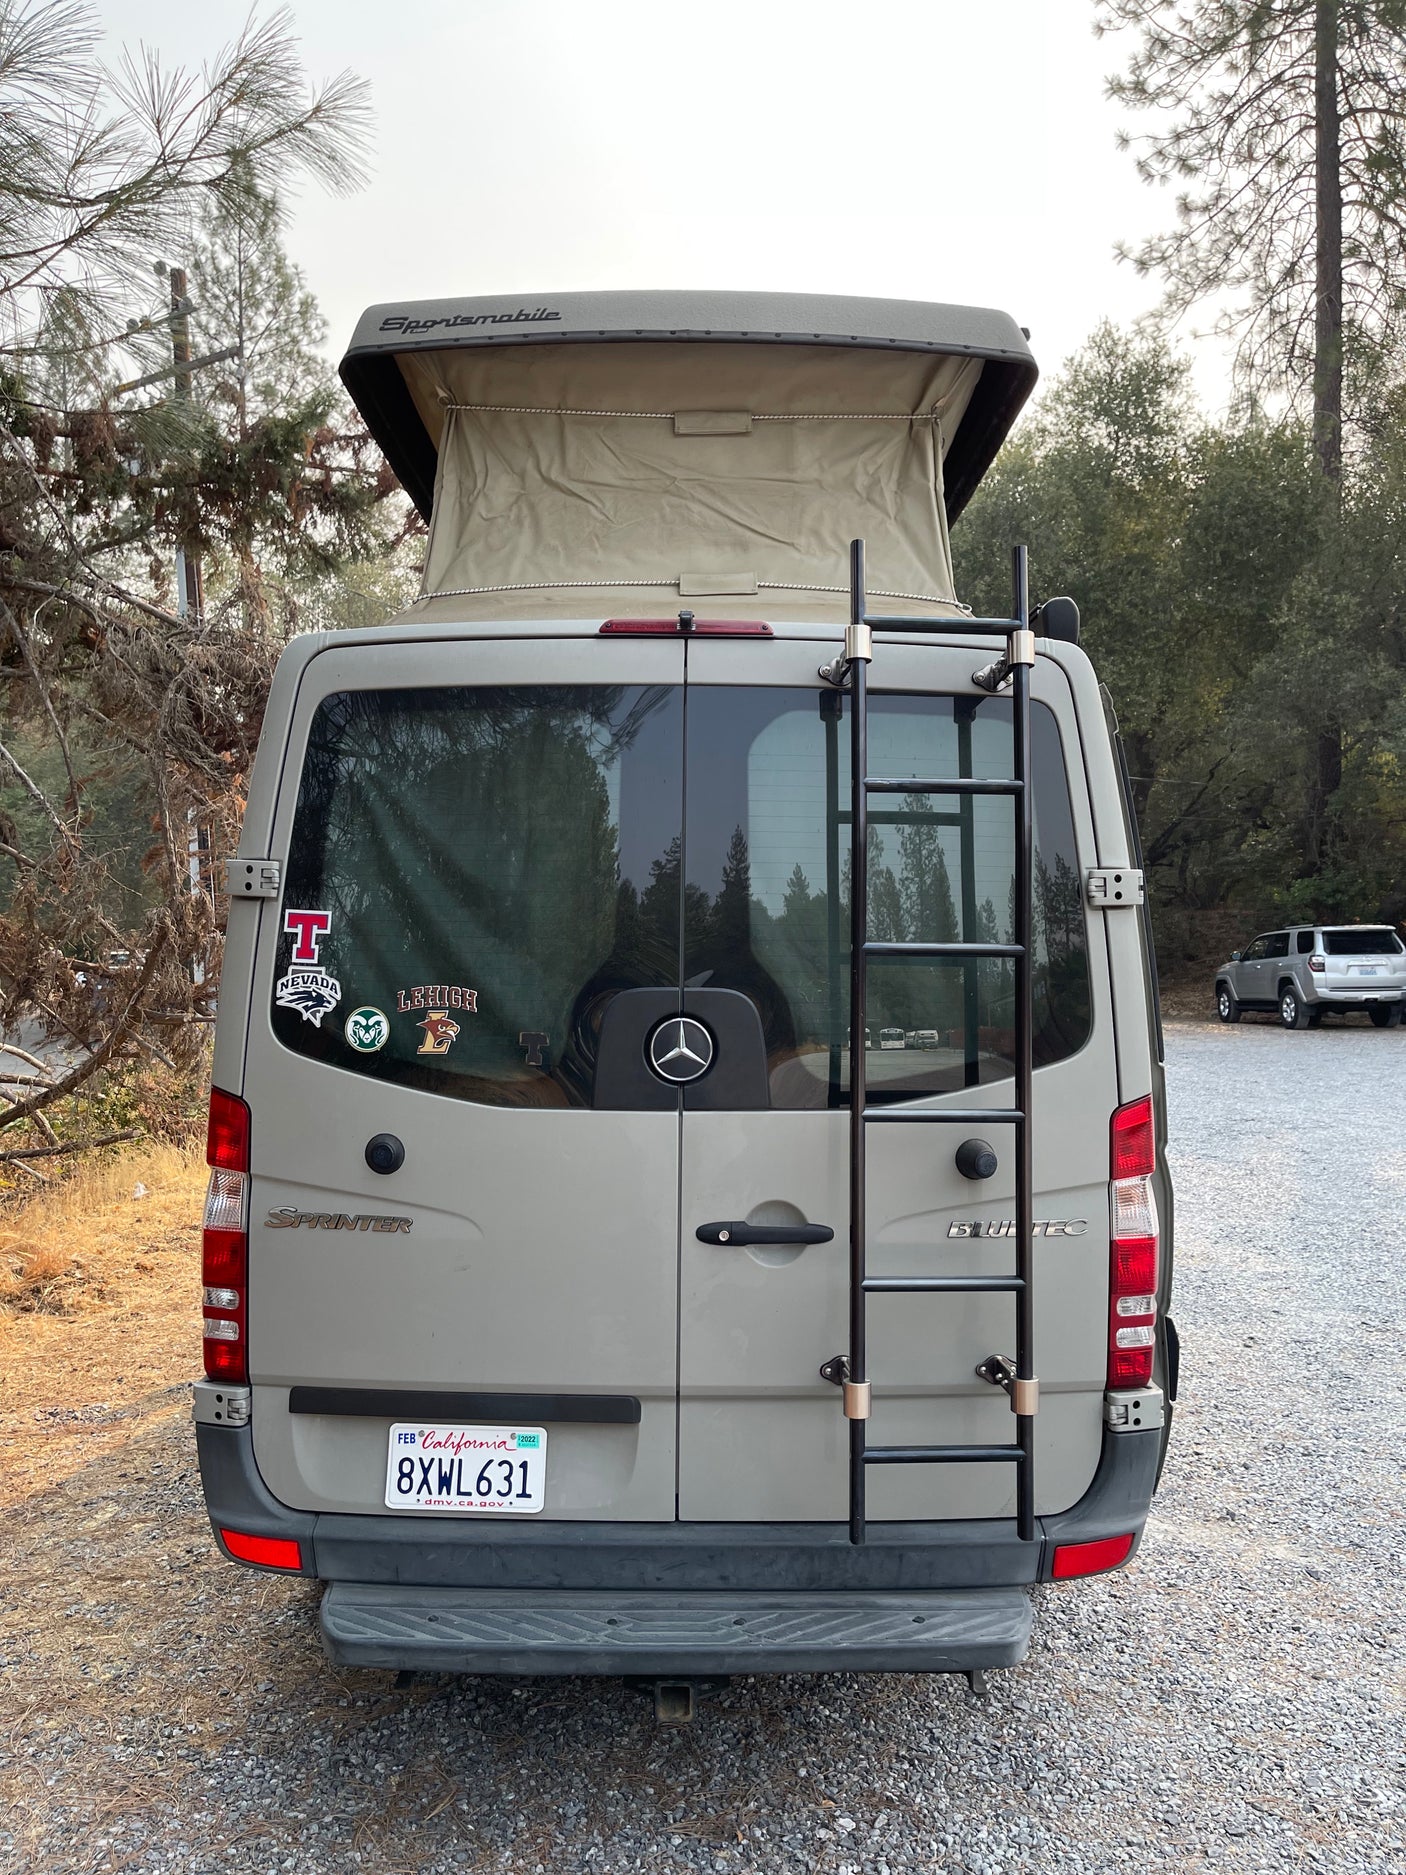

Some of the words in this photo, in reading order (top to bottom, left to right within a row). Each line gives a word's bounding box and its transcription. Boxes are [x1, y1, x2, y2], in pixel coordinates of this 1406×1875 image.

[379, 308, 562, 334] Sportsmobile
[285, 910, 331, 963] T
[280, 974, 338, 995] NEVADA
[397, 985, 478, 1013] LEHIGH
[264, 1206, 414, 1233] SPRINTER
[398, 1433, 416, 1444] FEB
[422, 1430, 517, 1456] California
[520, 1435, 536, 1443] 2022
[397, 1457, 532, 1499] 8XWL631
[424, 1498, 505, 1508] dmv.ca.gov
